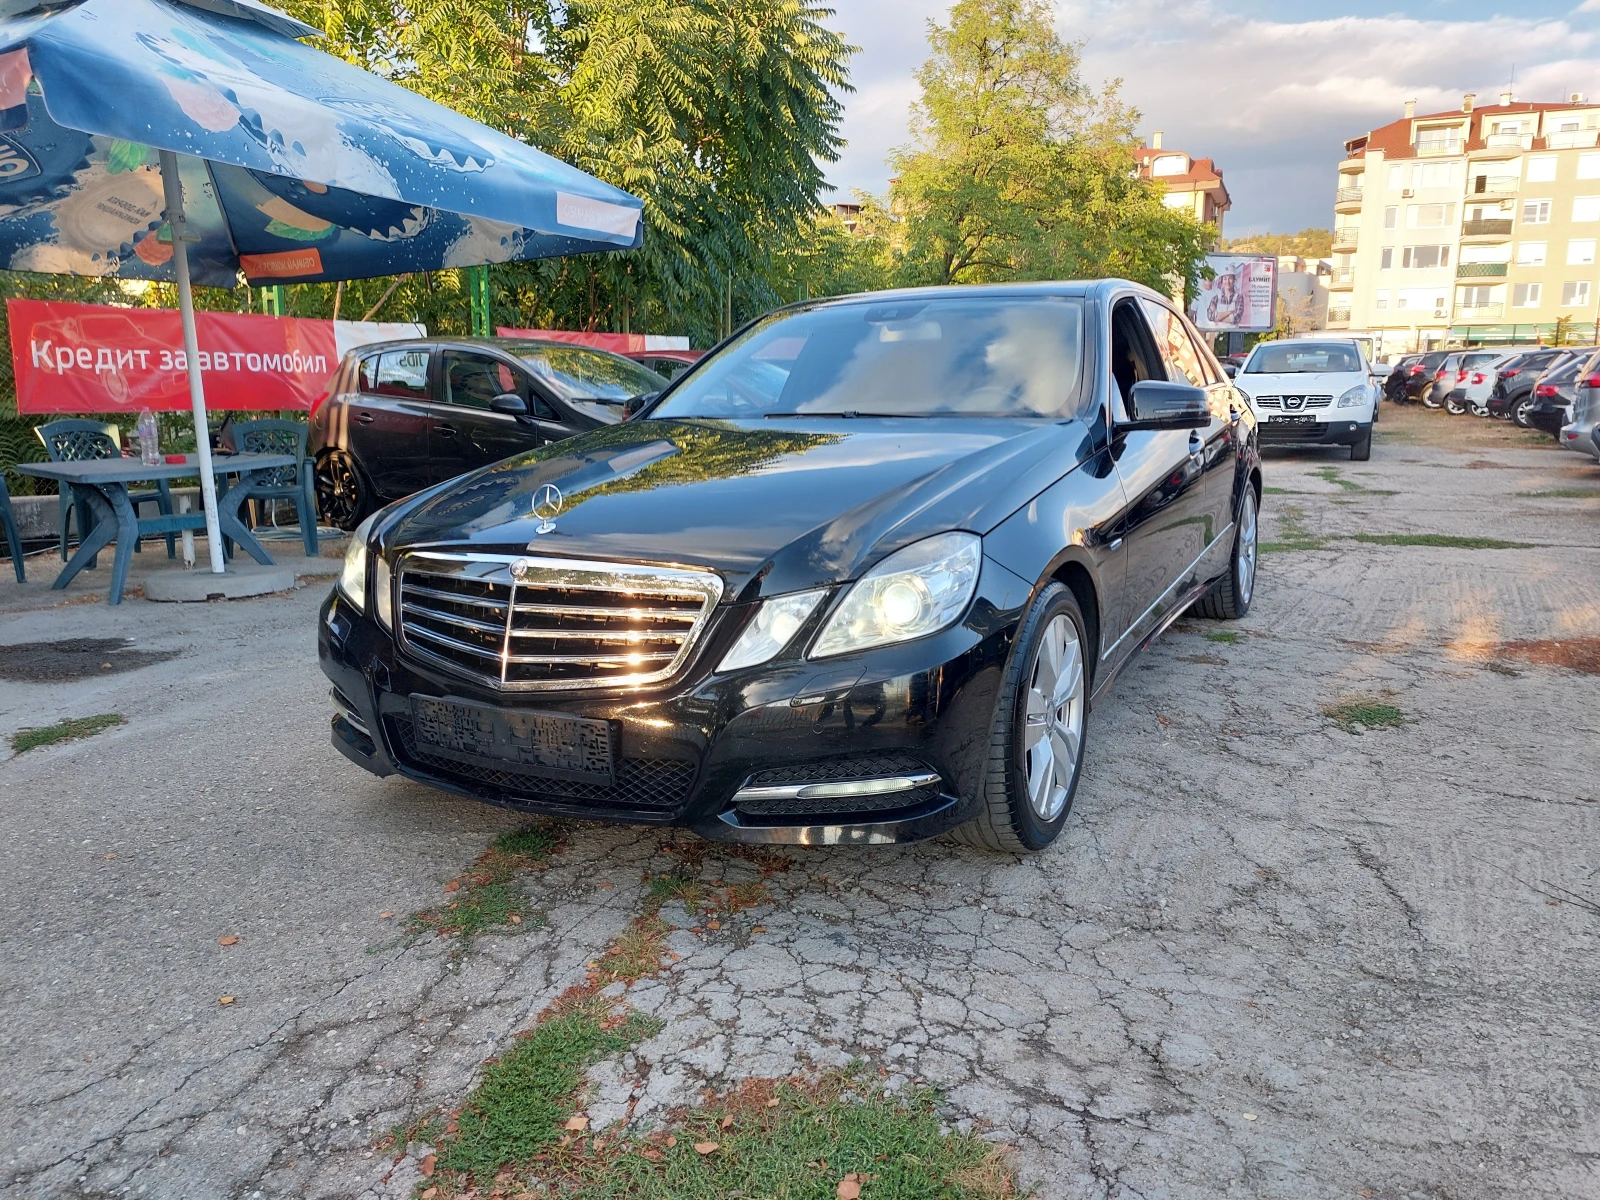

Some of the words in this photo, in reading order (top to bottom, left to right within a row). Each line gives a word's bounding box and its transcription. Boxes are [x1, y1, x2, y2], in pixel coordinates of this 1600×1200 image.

[31, 340, 150, 375] Кредит
[159, 349, 189, 371] за
[198, 349, 327, 374] автомобил
